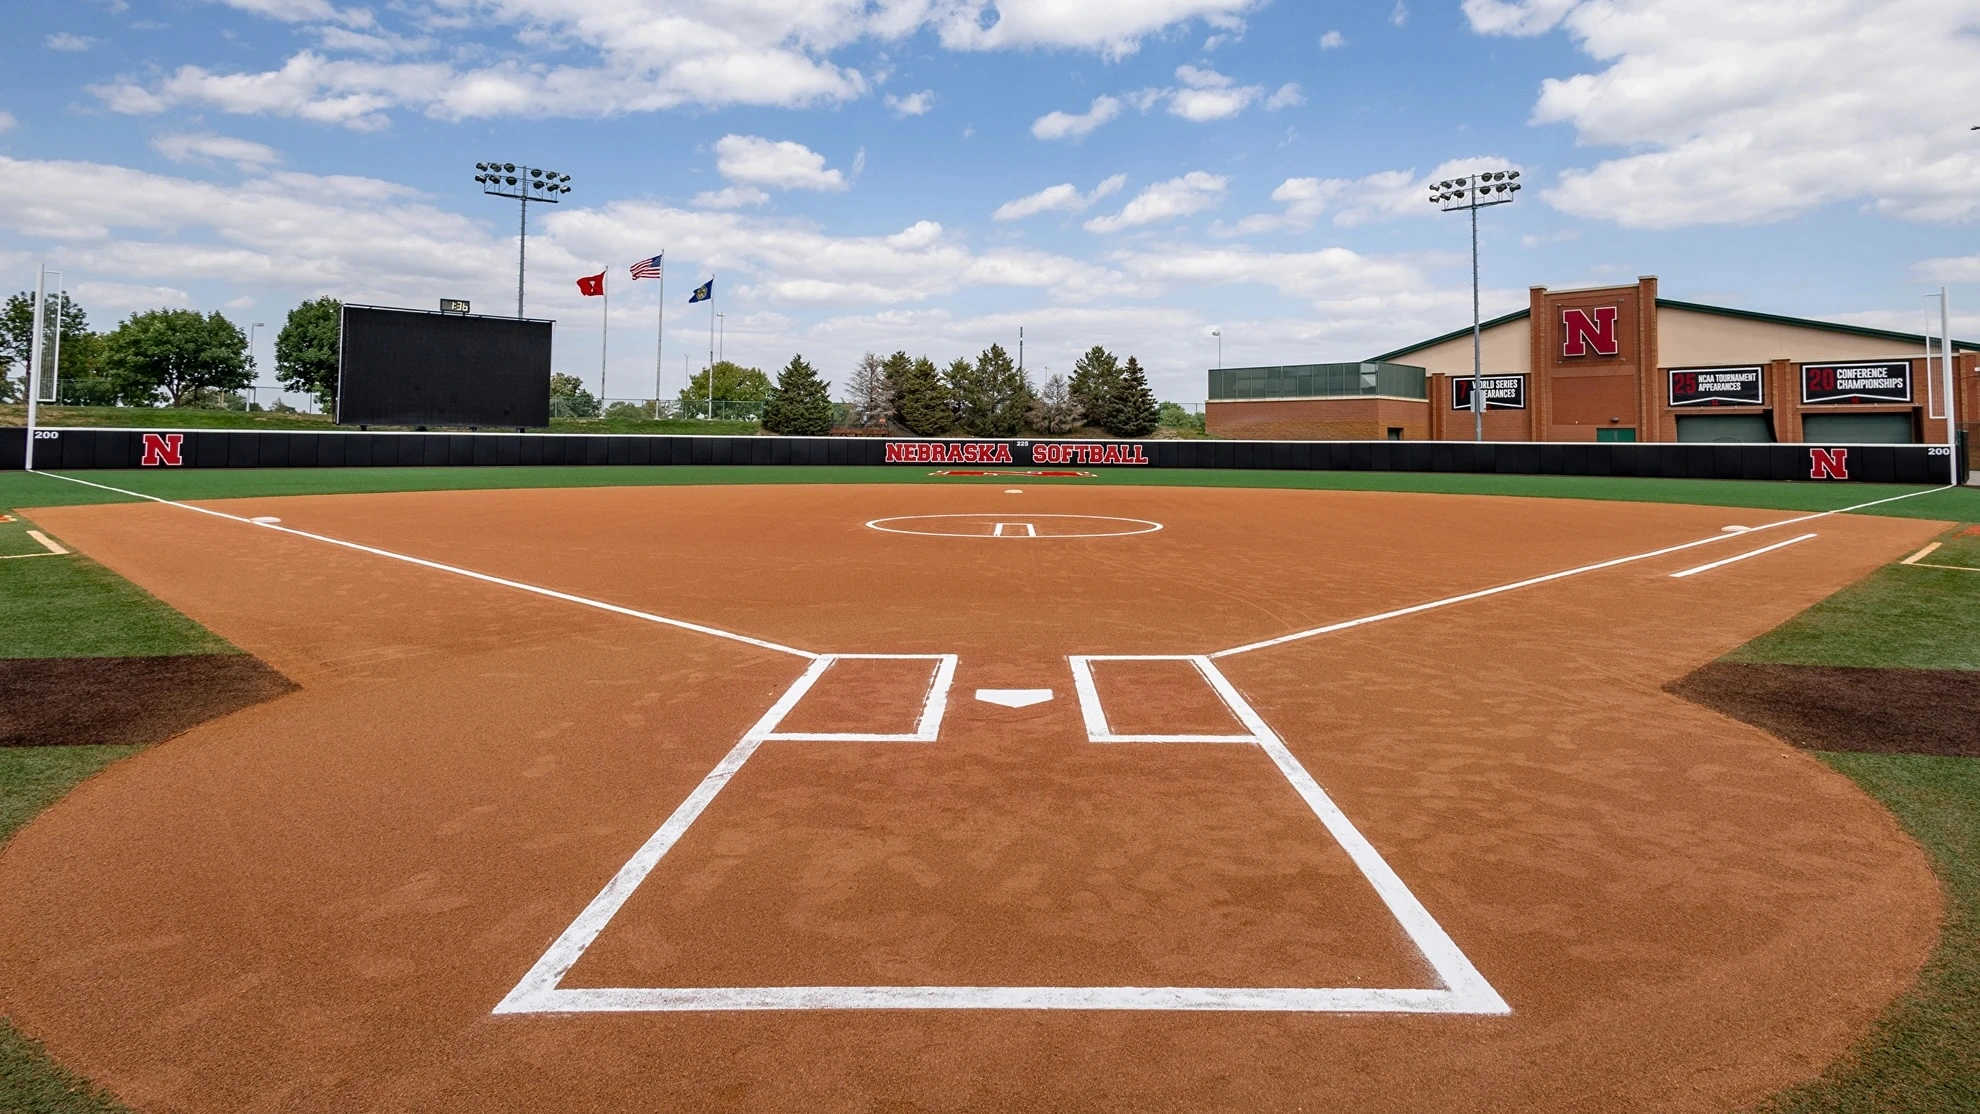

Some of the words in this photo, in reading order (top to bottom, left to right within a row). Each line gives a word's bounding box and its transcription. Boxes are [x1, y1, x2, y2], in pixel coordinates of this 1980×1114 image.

[451, 301, 469, 312] 1:36
[1563, 306, 1618, 356] N
[1698, 374, 1715, 383] NCAA
[1715, 373, 1757, 382] TOURNAMENT
[1836, 368, 1888, 379] CONFERENCE
[1495, 380, 1518, 389] SERIES
[1673, 373, 1697, 394] 25
[1809, 368, 1834, 391] 20
[1836, 378, 1904, 389] CHAMPIONSHIPS
[1459, 380, 1468, 399] 7
[1698, 382, 1741, 392] APPEARANCES
[34, 431, 59, 439] 200
[141, 434, 183, 466] N
[885, 443, 1013, 463] NEBRASKA
[1032, 444, 1149, 464] SOFTBALL
[1927, 447, 1950, 456] 200
[1810, 448, 1848, 480] N
